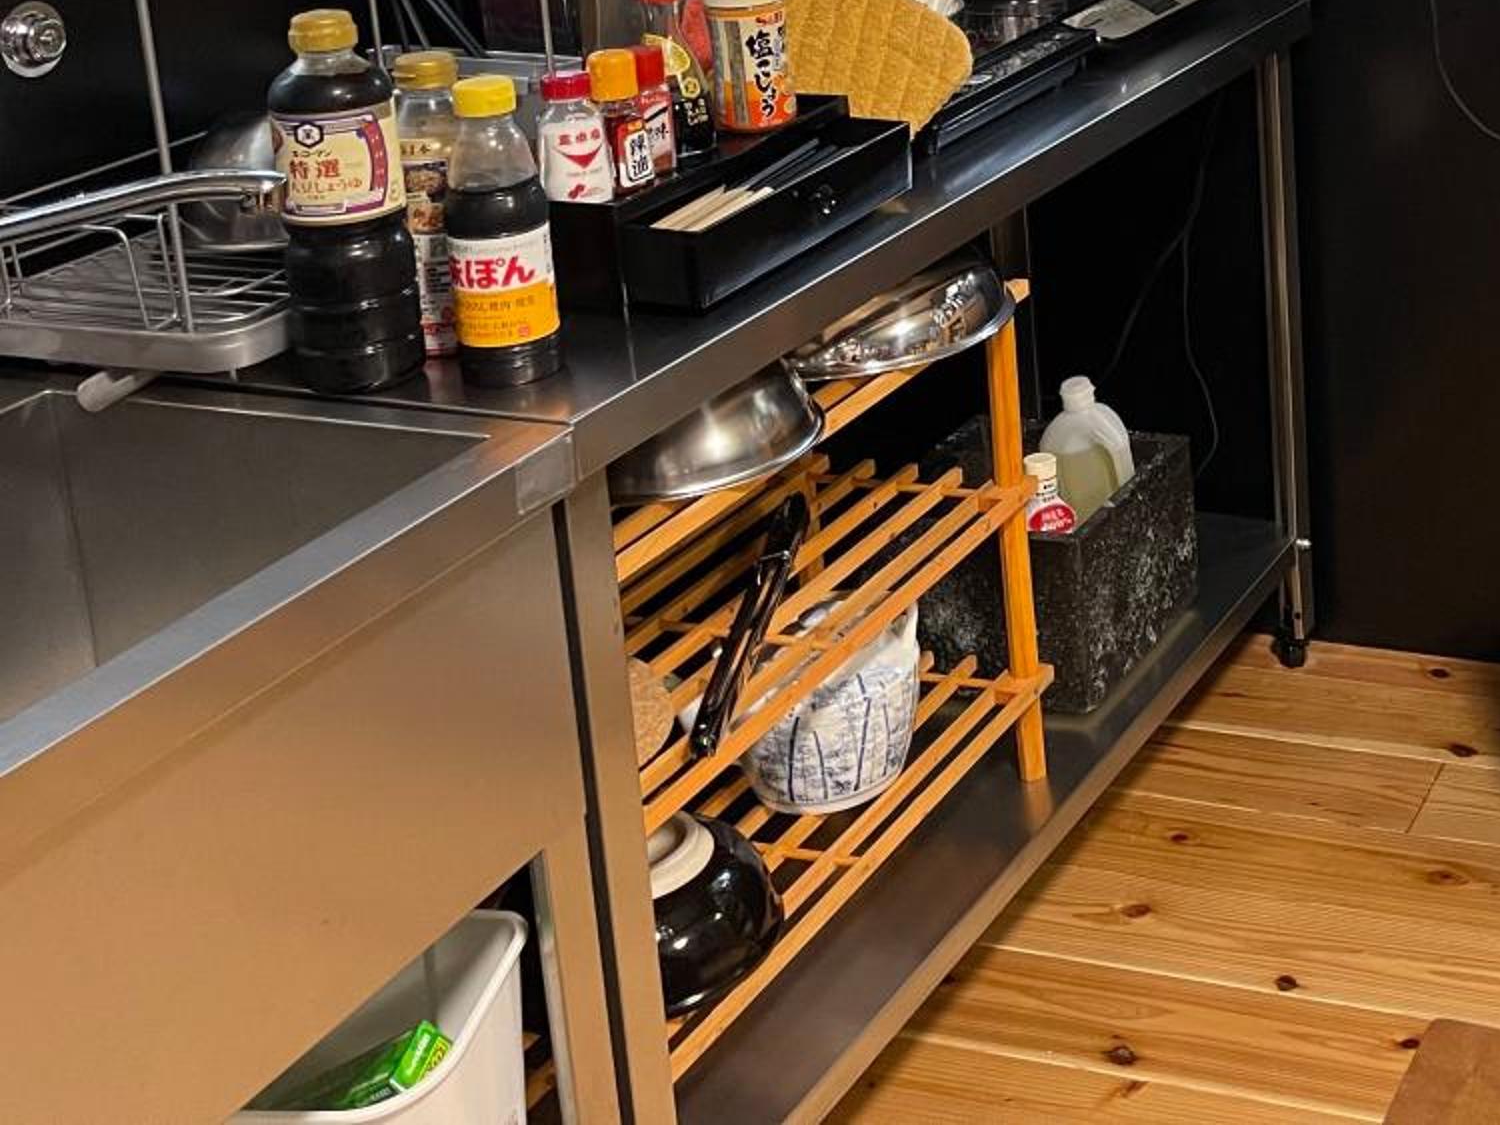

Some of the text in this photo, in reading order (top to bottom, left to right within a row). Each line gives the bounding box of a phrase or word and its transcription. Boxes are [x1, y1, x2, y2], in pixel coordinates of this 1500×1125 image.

[745, 28, 777, 117] 塩こしょう
[288, 157, 341, 179] 特選
